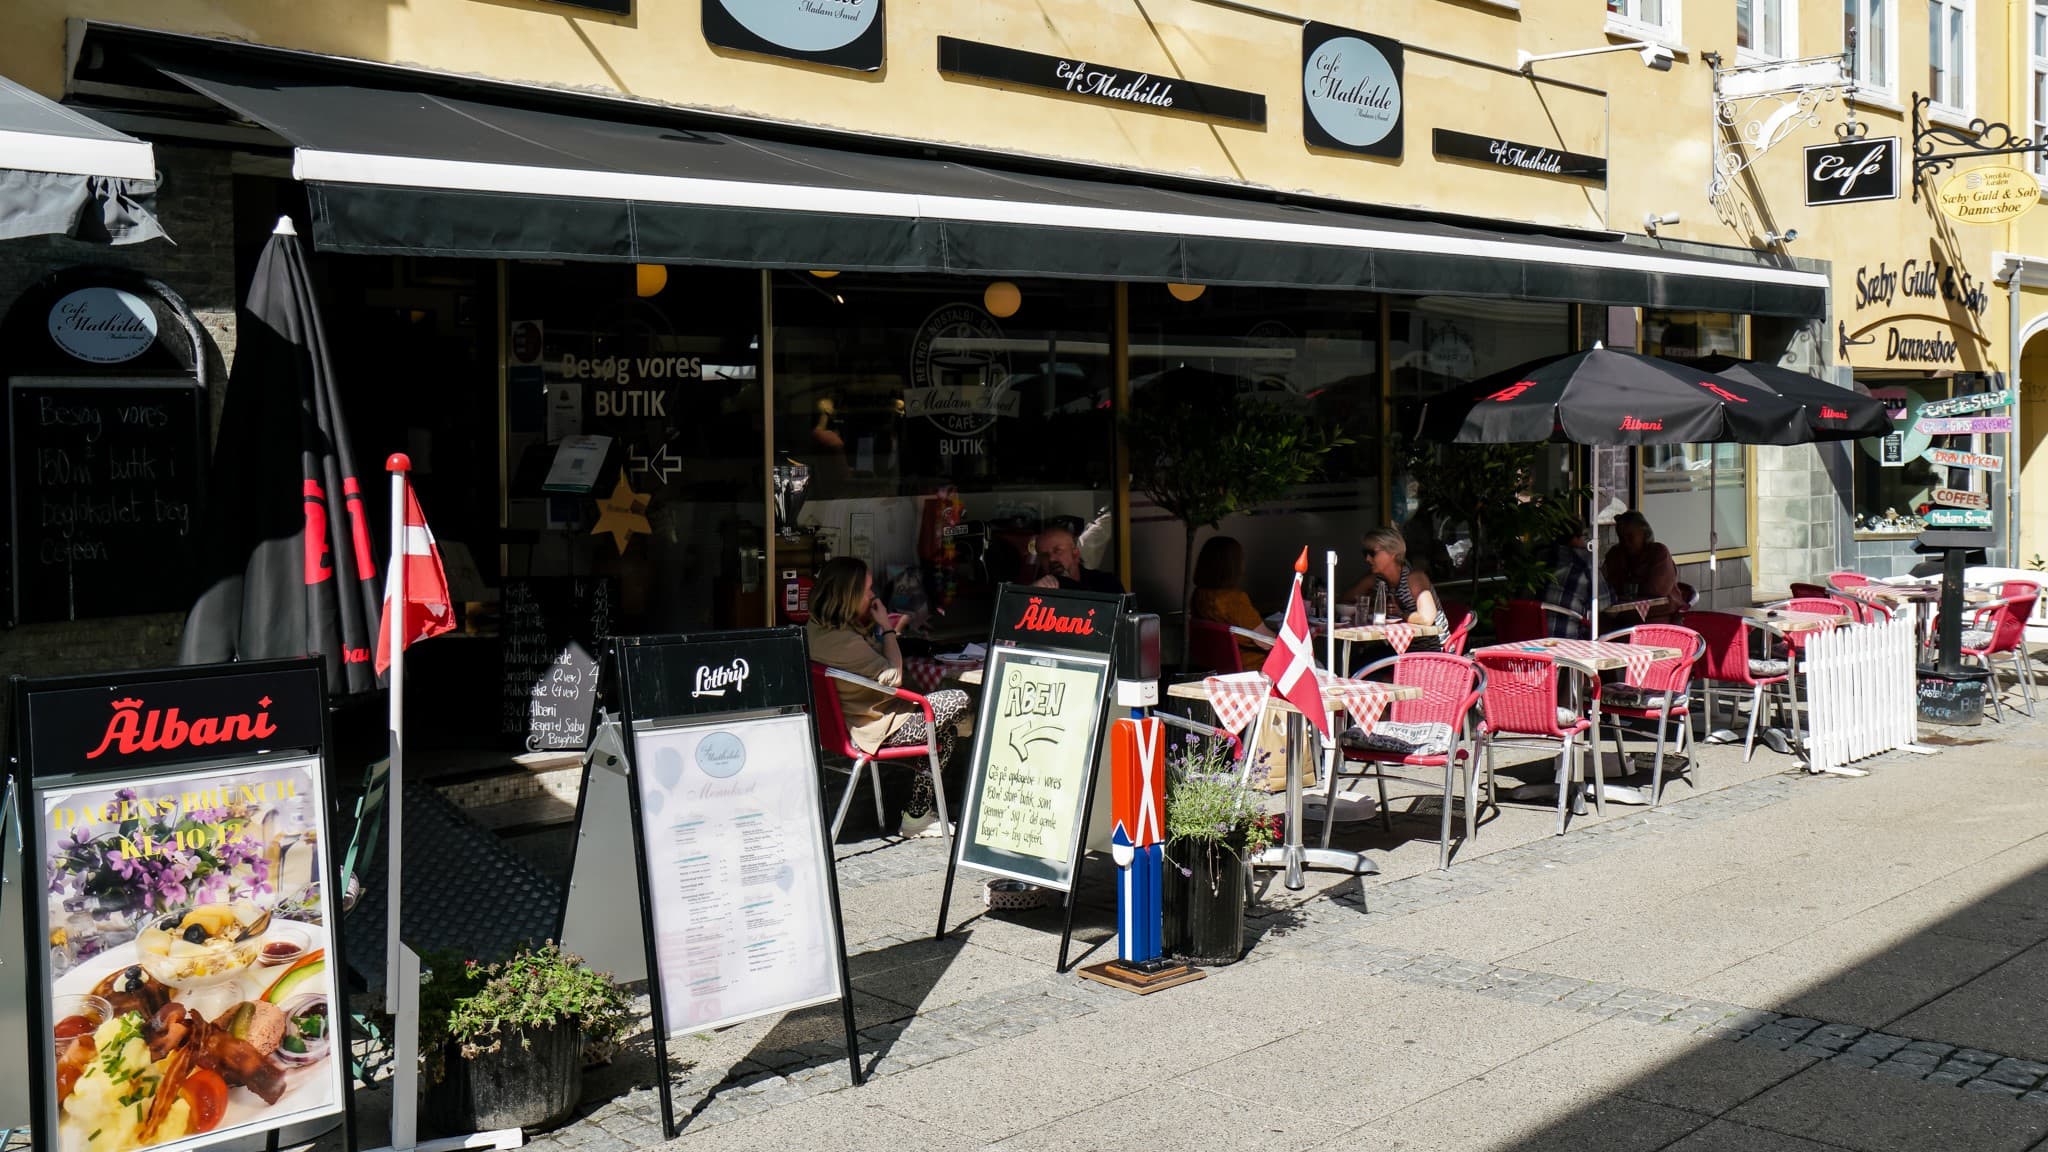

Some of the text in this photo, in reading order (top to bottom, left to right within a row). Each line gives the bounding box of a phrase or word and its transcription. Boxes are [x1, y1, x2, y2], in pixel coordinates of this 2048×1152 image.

[799, 1, 833, 17] Madam
[1316, 54, 1342, 80] Café
[1056, 60, 1173, 107] Café Mathilde
[1313, 76, 1391, 110] Mathilde
[1490, 141, 1561, 174] Café Mathilde
[1813, 145, 1886, 196] Café
[1942, 193, 1969, 205] Sæby
[1973, 190, 1999, 202] Guld
[2002, 189, 2011, 199] &
[1958, 202, 2022, 217] Dannesboe
[1856, 263, 1897, 312] Sæby
[1902, 259, 1940, 299] Guld
[1942, 266, 1956, 300] &
[58, 313, 146, 331] Mathilde
[1886, 327, 1958, 363] Dannesboe
[562, 353, 701, 385] Besøg vores
[594, 390, 666, 417] BUTIK
[1971, 390, 2008, 409] SHOP
[117, 405, 168, 426] vores
[939, 439, 984, 456] BUTIK
[1937, 490, 1980, 506] COFFEE
[1932, 511, 1963, 524] Madam
[1014, 597, 1095, 635] Albani
[1004, 670, 1066, 717] ÅBEN
[87, 696, 278, 759] Albani
[1044, 776, 1063, 790] vores
[53, 778, 296, 831] DAGENS BRUNCH
[120, 834, 169, 860] KL.
